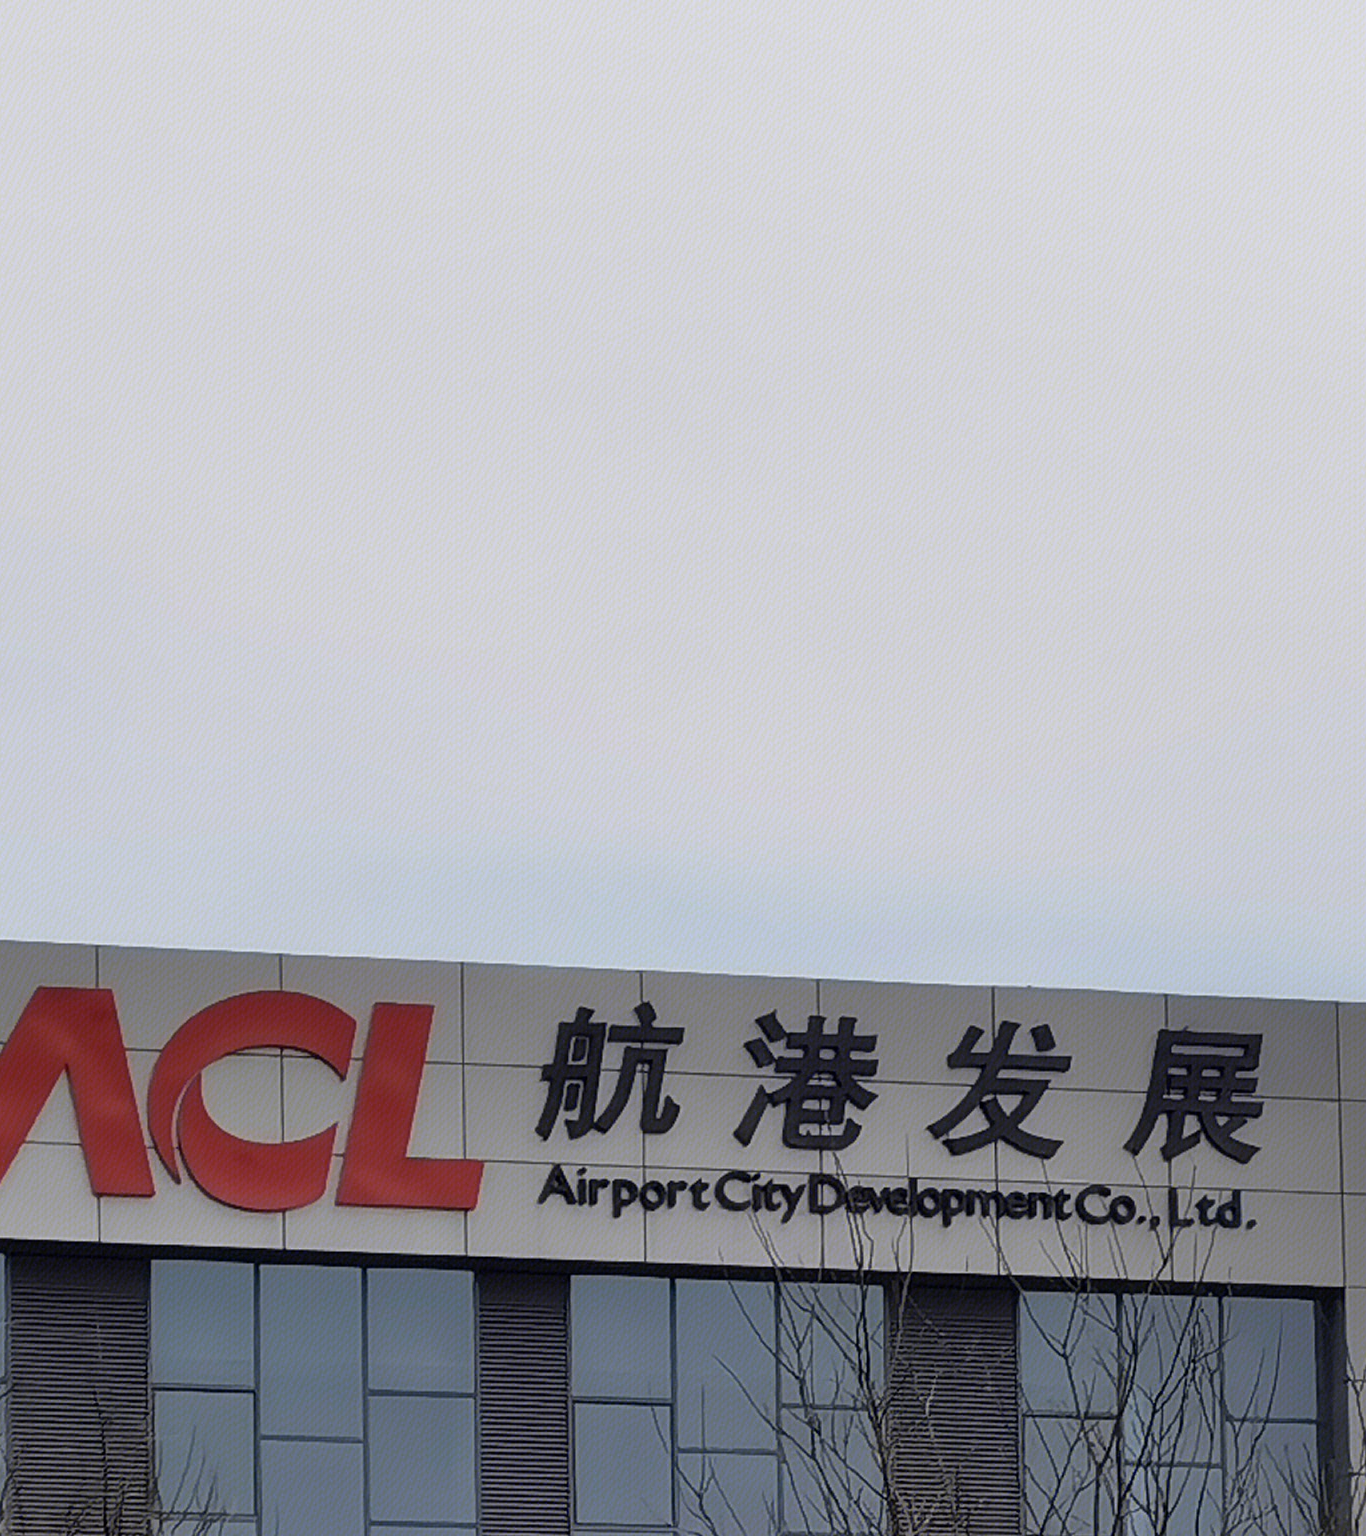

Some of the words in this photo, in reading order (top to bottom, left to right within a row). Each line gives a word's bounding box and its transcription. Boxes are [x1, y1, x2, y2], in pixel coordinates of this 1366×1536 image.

[535, 1002, 1264, 1164] 航港发展
[539, 1163, 711, 1219] Airport
[714, 1170, 807, 1224] City
[808, 1173, 1073, 1228] Development
